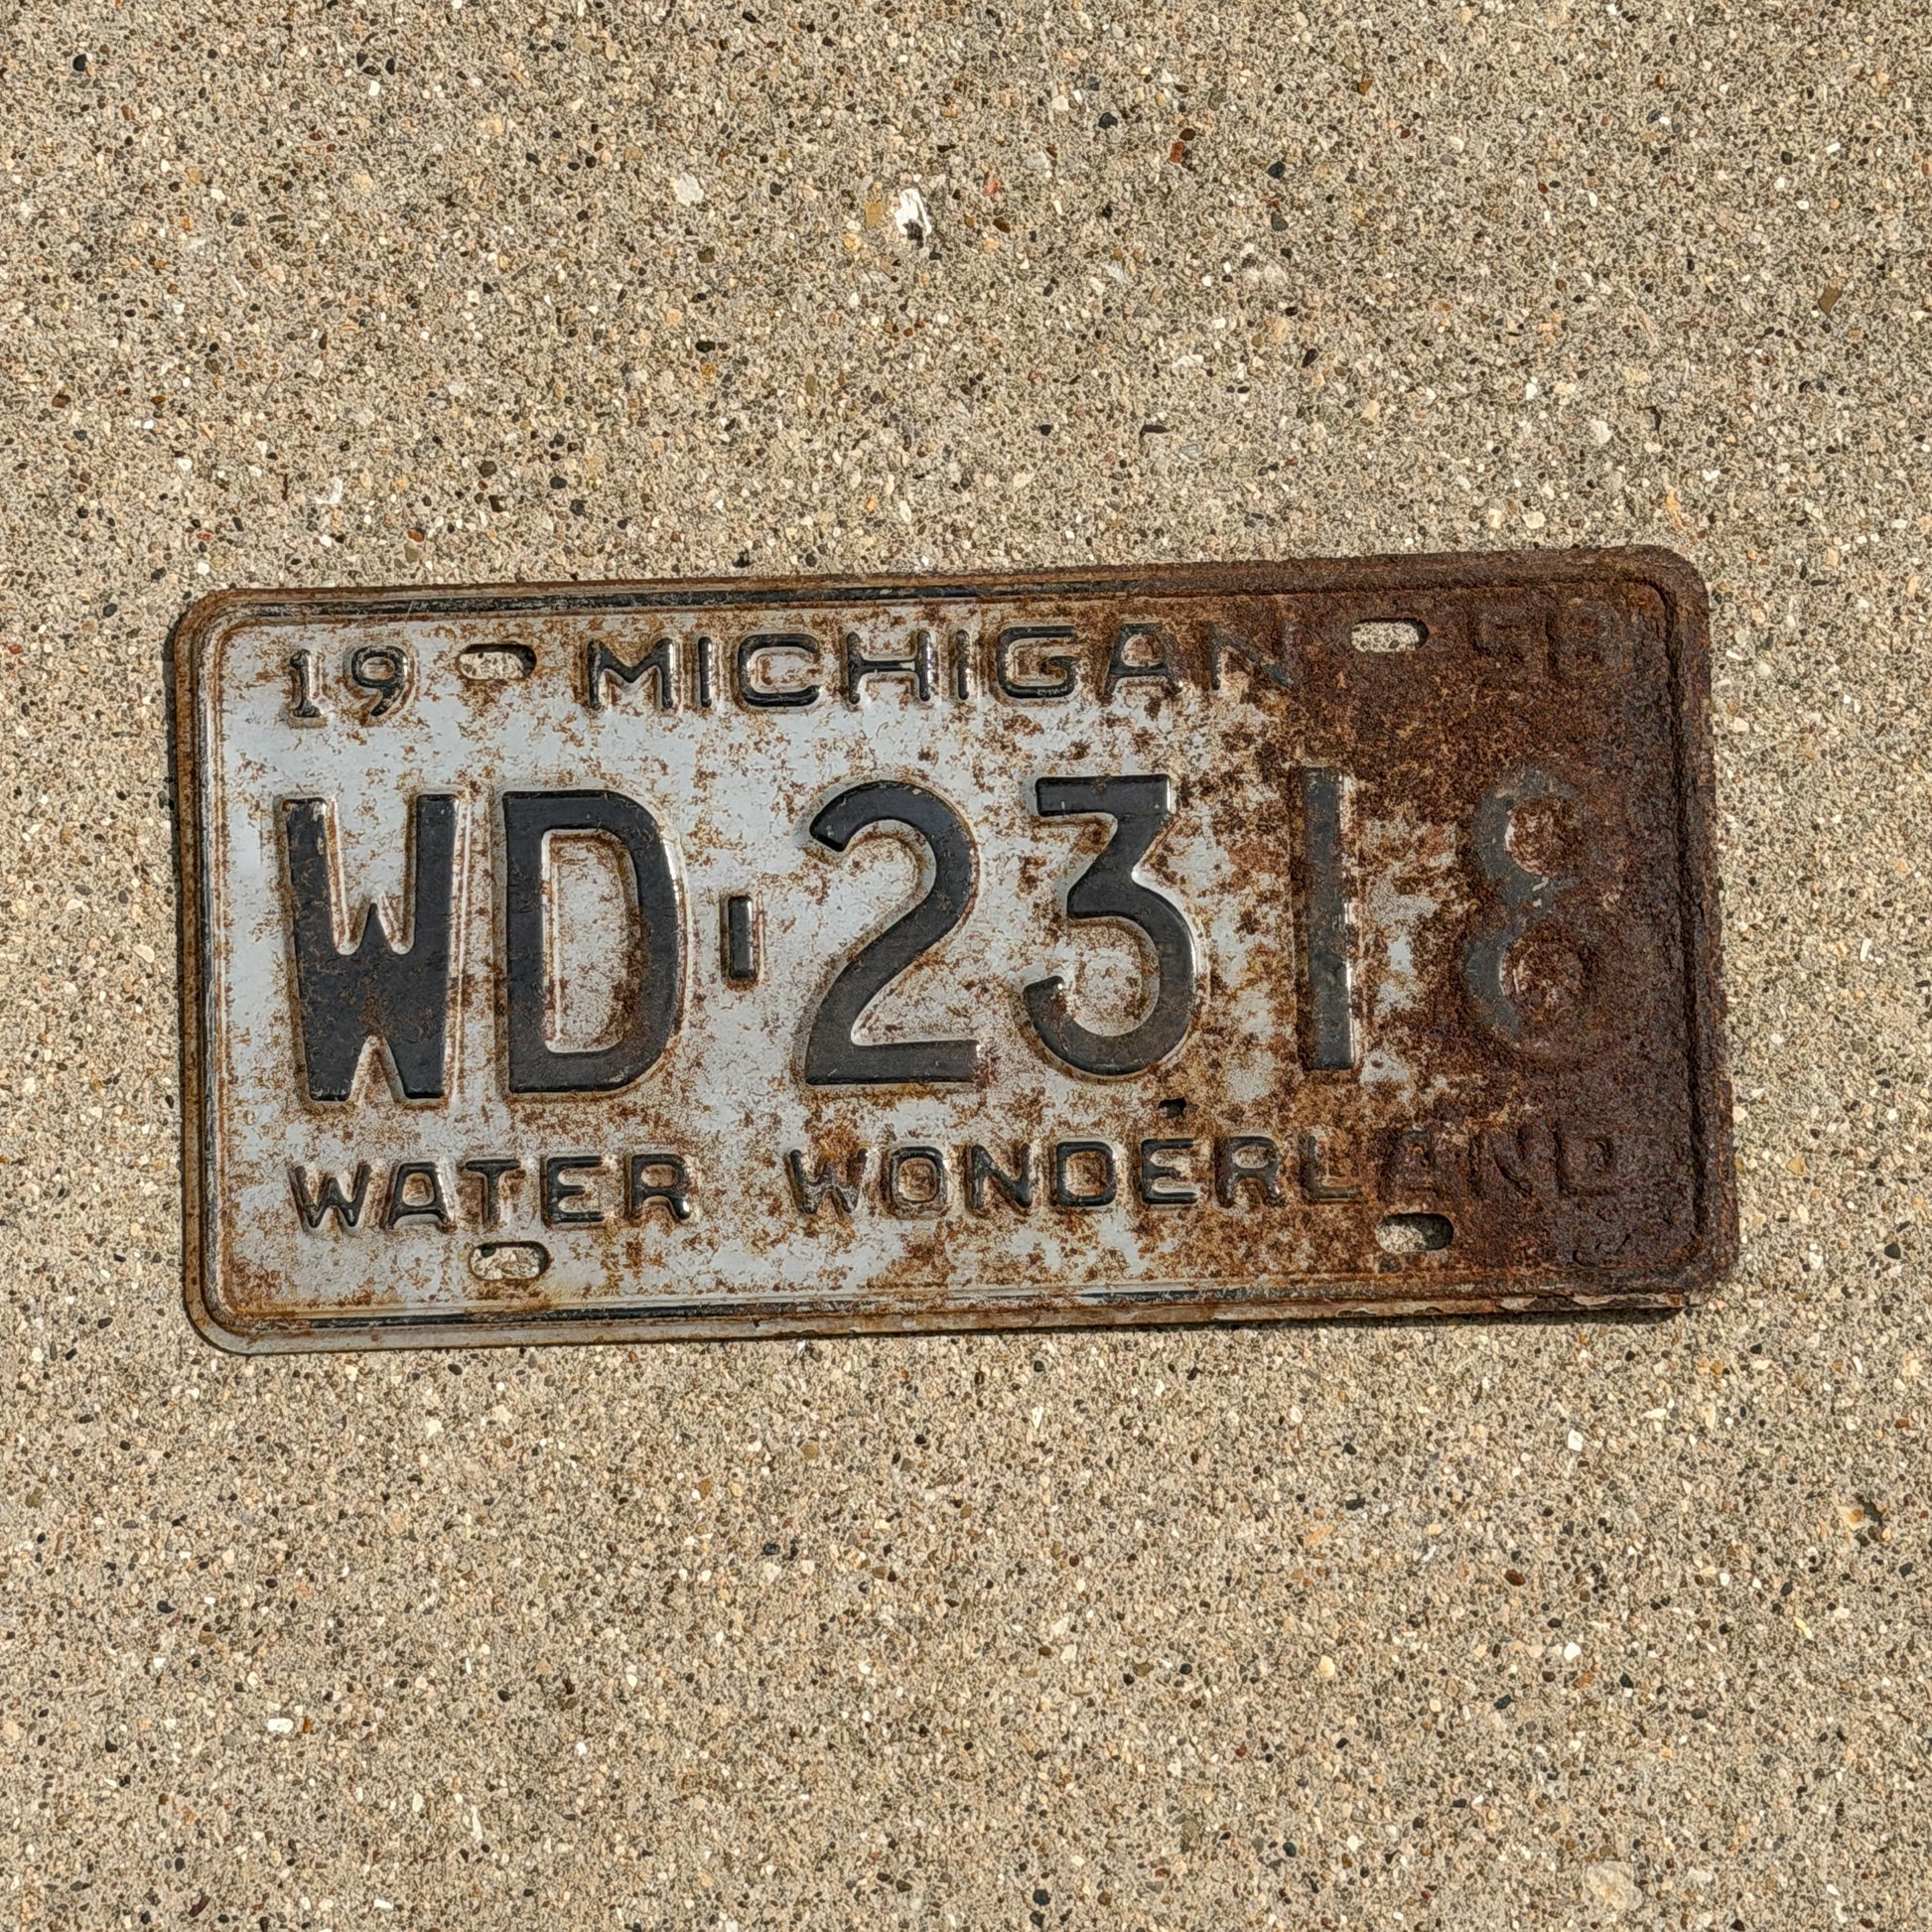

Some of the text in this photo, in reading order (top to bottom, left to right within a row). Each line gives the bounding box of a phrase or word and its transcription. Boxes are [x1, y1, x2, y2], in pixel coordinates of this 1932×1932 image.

[289, 645, 408, 719] 19
[588, 618, 1296, 711] MICHIGAN
[292, 1125, 1628, 1233] WATER WONDERLAND
